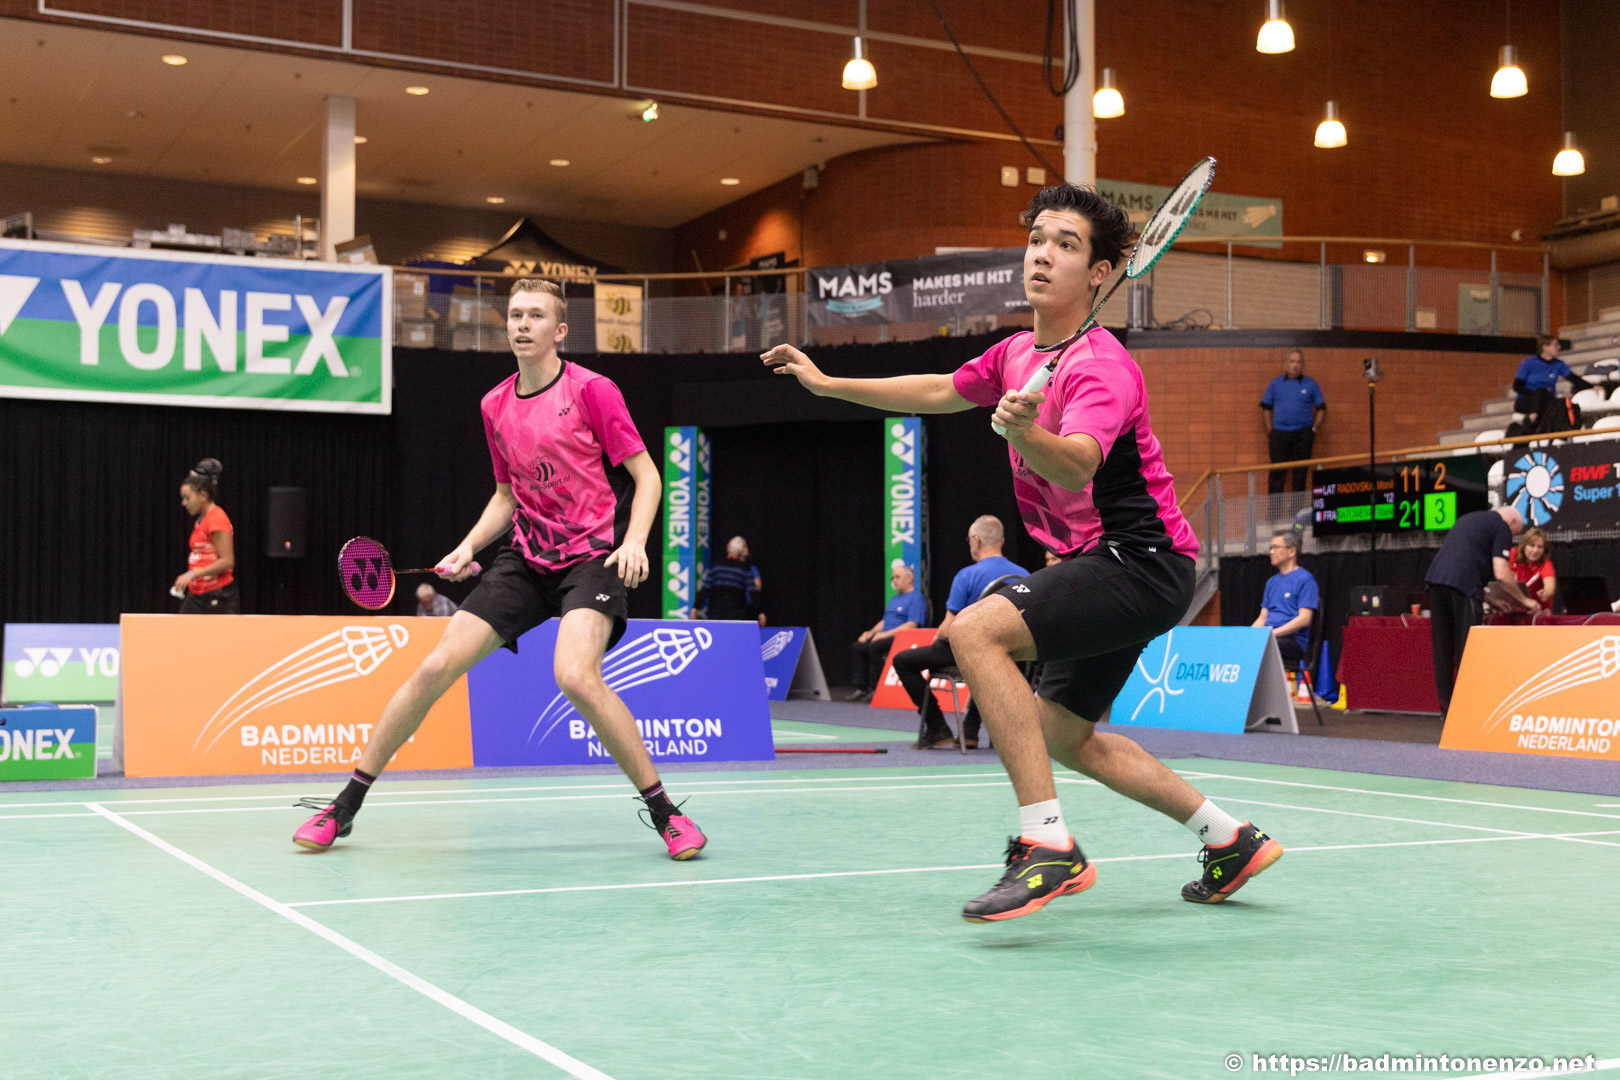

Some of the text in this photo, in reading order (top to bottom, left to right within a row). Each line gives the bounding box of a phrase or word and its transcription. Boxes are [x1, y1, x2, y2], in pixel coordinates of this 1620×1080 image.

[540, 261, 598, 285] YONEX
[818, 271, 893, 299] MAMS
[912, 269, 1013, 290] MAKES ME HIT
[912, 289, 965, 307] harder
[60, 278, 350, 377] YONEX
[1322, 483, 1336, 496] LAT
[1400, 465, 1420, 493] 11
[1433, 462, 1447, 490] 2
[1570, 463, 1611, 482] BWF
[1574, 485, 1614, 502] Super
[668, 477, 690, 549] YONEX
[696, 478, 710, 549] YONEX
[890, 470, 915, 545] YONEX
[1322, 510, 1337, 521] FRA
[1399, 499, 1420, 528] 21
[1434, 498, 1446, 524] 3
[1175, 662, 1241, 683] DATAWEB
[240, 723, 415, 747] BADMINT
[1517, 733, 1611, 753] NEDERLAND
[261, 746, 398, 766] NEDERLA
[588, 739, 708, 757] NRLAND
